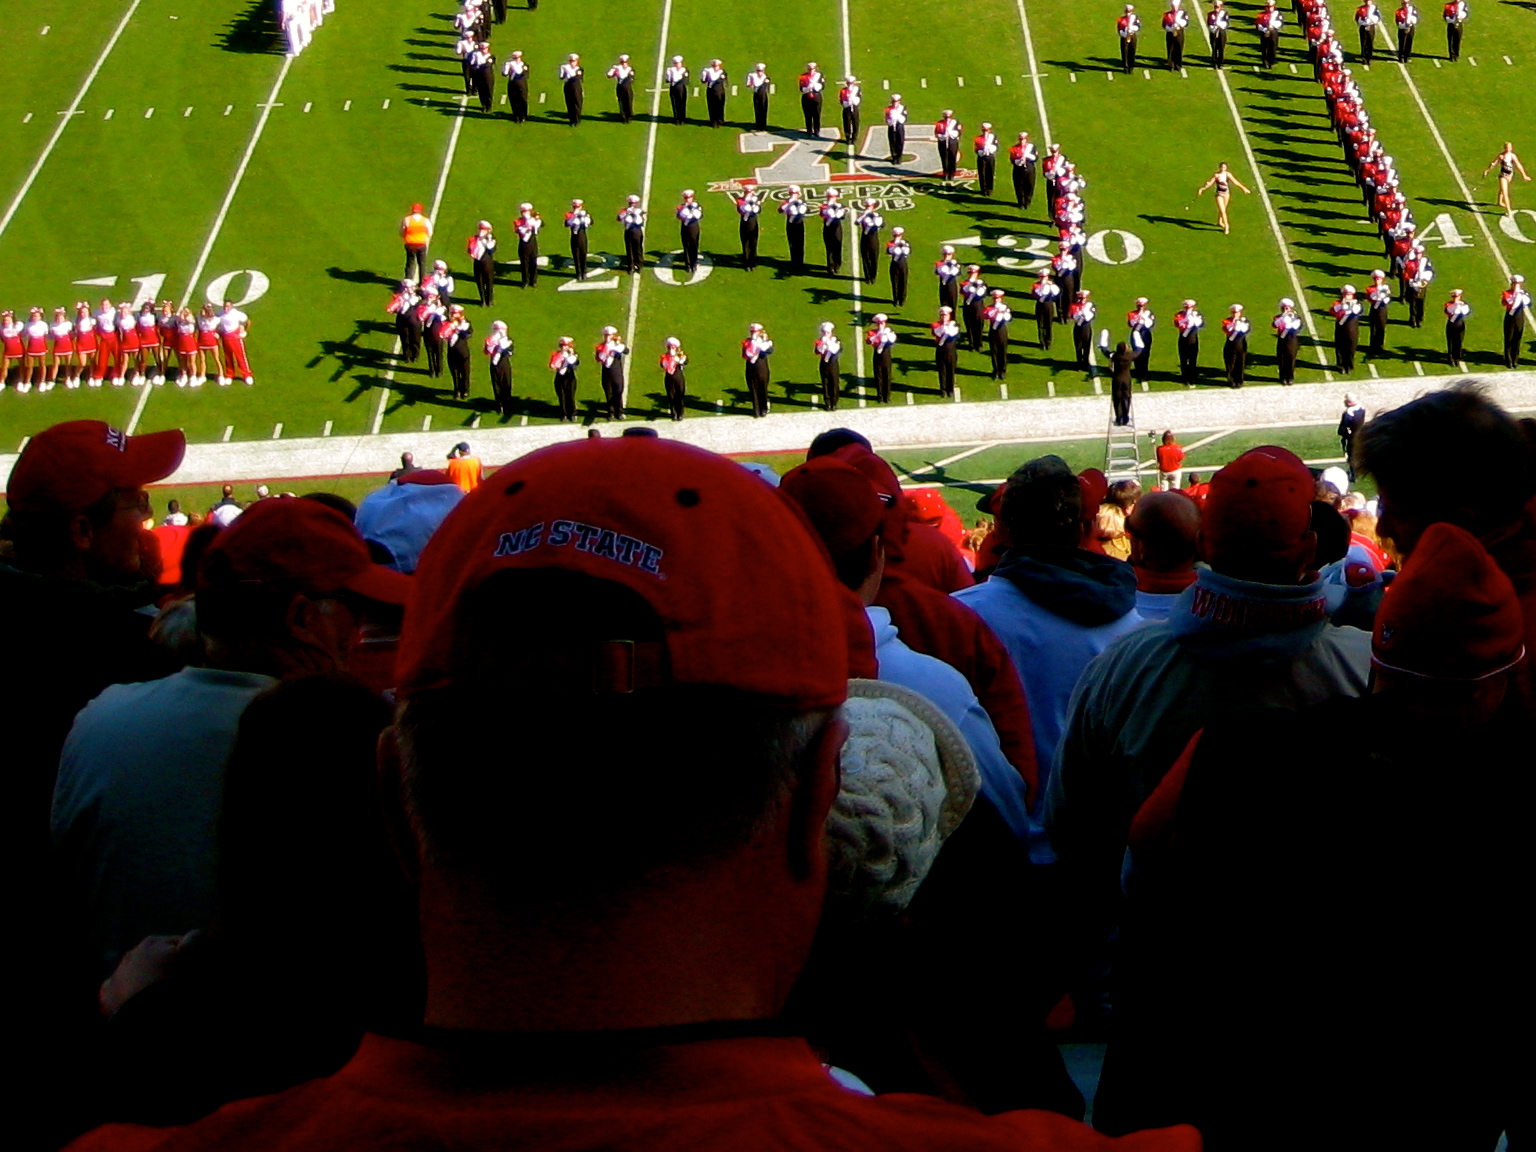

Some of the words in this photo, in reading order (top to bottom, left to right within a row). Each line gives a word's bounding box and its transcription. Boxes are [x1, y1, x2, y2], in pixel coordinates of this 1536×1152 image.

[737, 124, 962, 184] 75
[803, 196, 916, 216] CUB
[997, 228, 1145, 269] 30
[130, 269, 270, 312] 10
[557, 249, 714, 292] 20
[493, 521, 545, 557] NC
[547, 519, 664, 575] STATE
